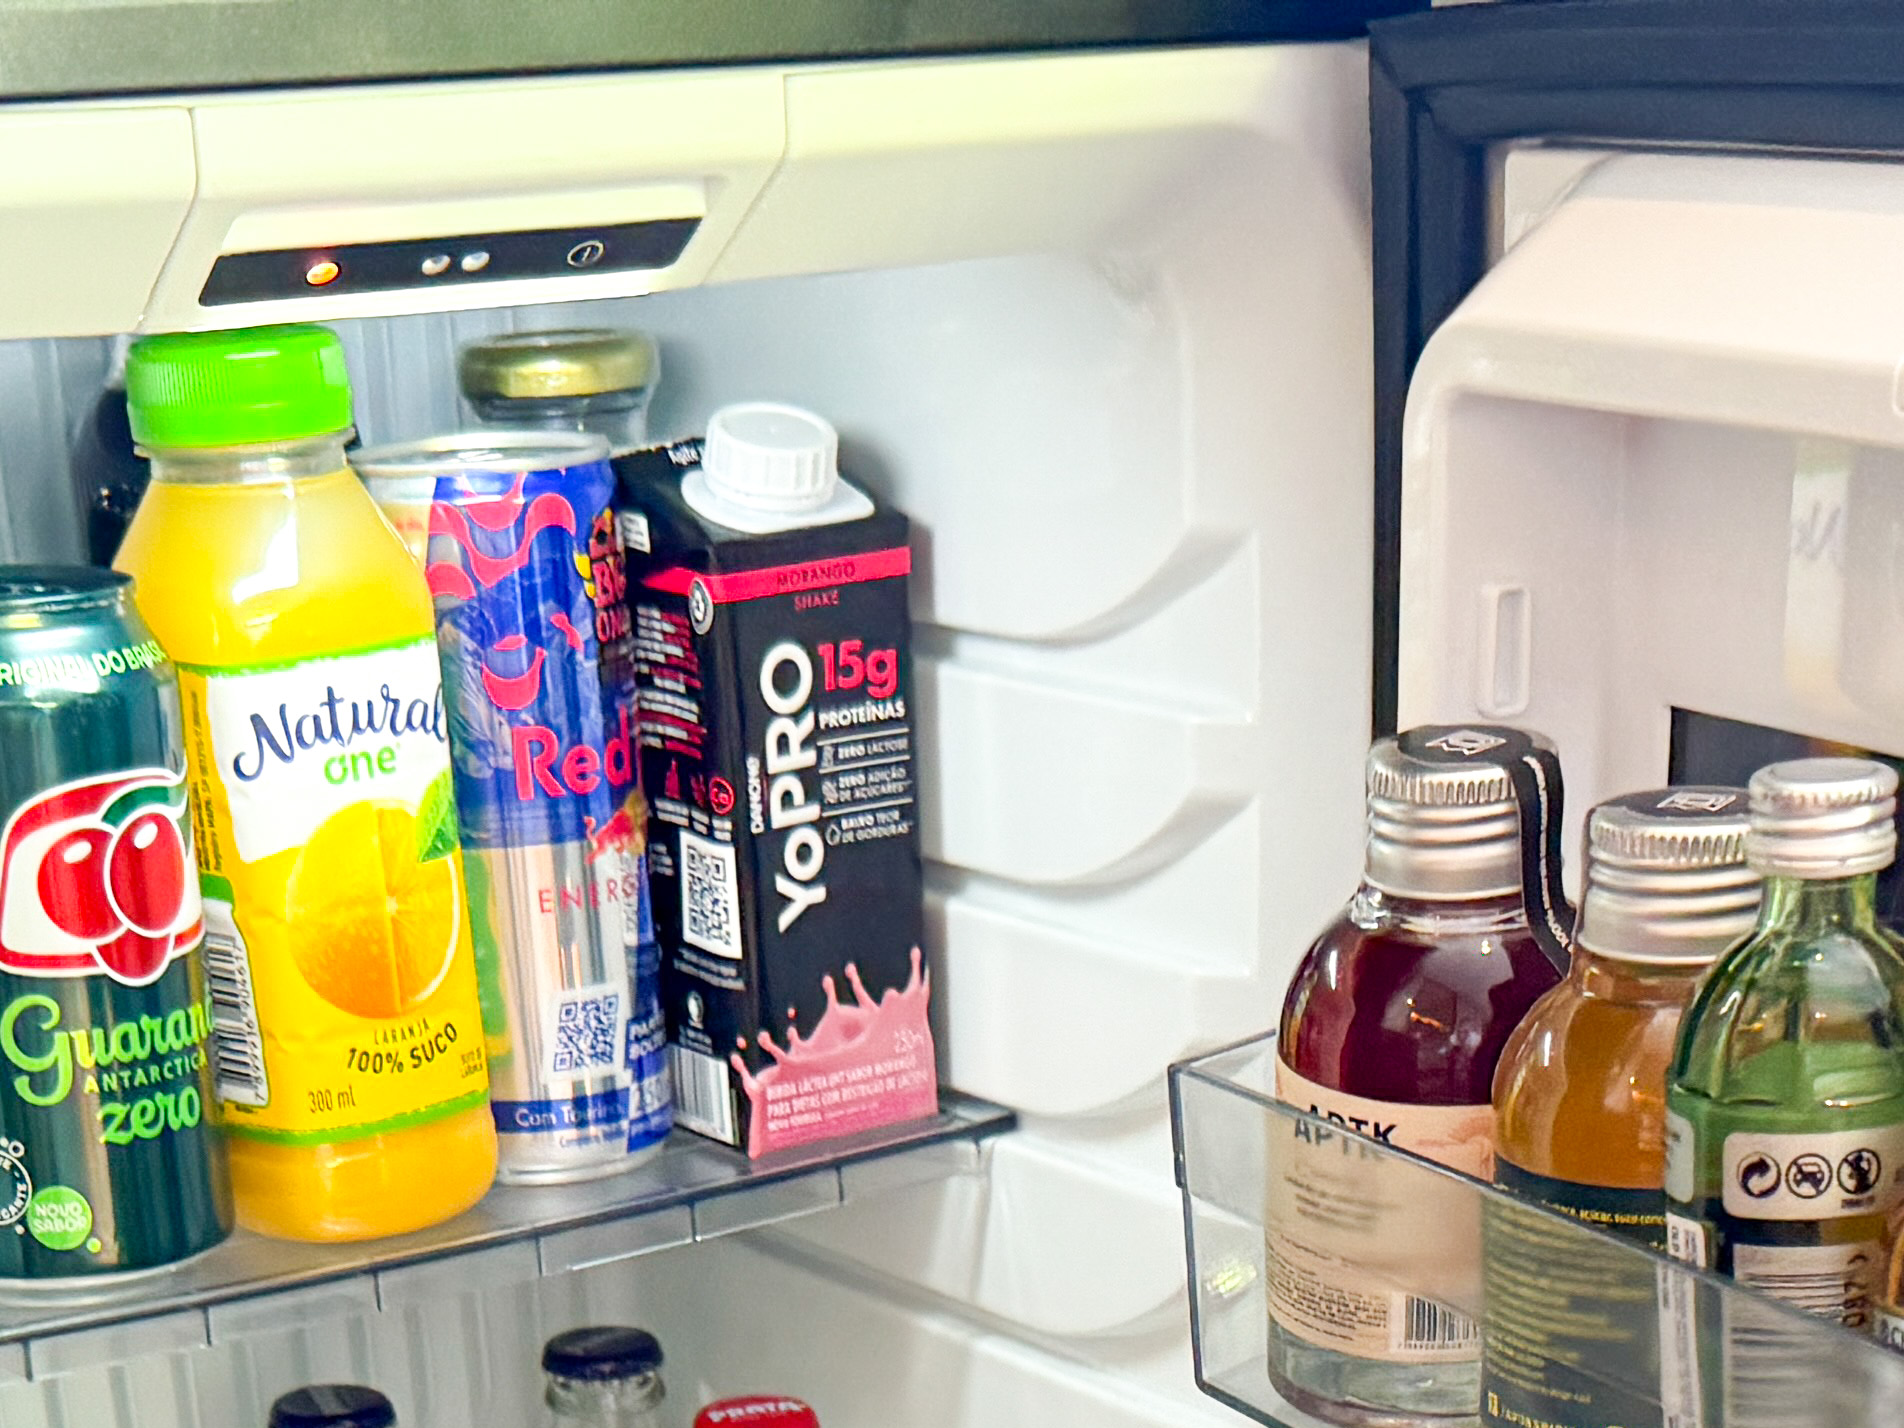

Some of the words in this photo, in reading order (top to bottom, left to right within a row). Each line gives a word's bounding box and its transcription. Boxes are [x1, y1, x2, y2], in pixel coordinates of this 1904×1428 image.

[777, 561, 857, 586] MORANGO
[793, 589, 840, 611] SHAKE
[92, 650, 127, 676] DO
[817, 638, 898, 699] 15g
[233, 684, 447, 782] Natural
[818, 700, 906, 730] PROTEÍNAS
[324, 745, 398, 785] one
[511, 703, 633, 801] Red
[838, 743, 866, 760] ZERO
[760, 641, 828, 933] YoPRO
[539, 875, 639, 914] ENERG
[347, 1047, 404, 1075] 100%
[410, 1022, 458, 1069] SUCO
[374, 1017, 430, 1045] LARANJA
[83, 1047, 208, 1095] ANTARCTICA
[97, 1085, 201, 1145] zero
[308, 1088, 333, 1114] 300
[338, 1084, 356, 1109] ml
[1295, 1104, 1397, 1160] APTK
[34, 1215, 86, 1234] SABOR
[35, 1200, 84, 1217] NOVO
